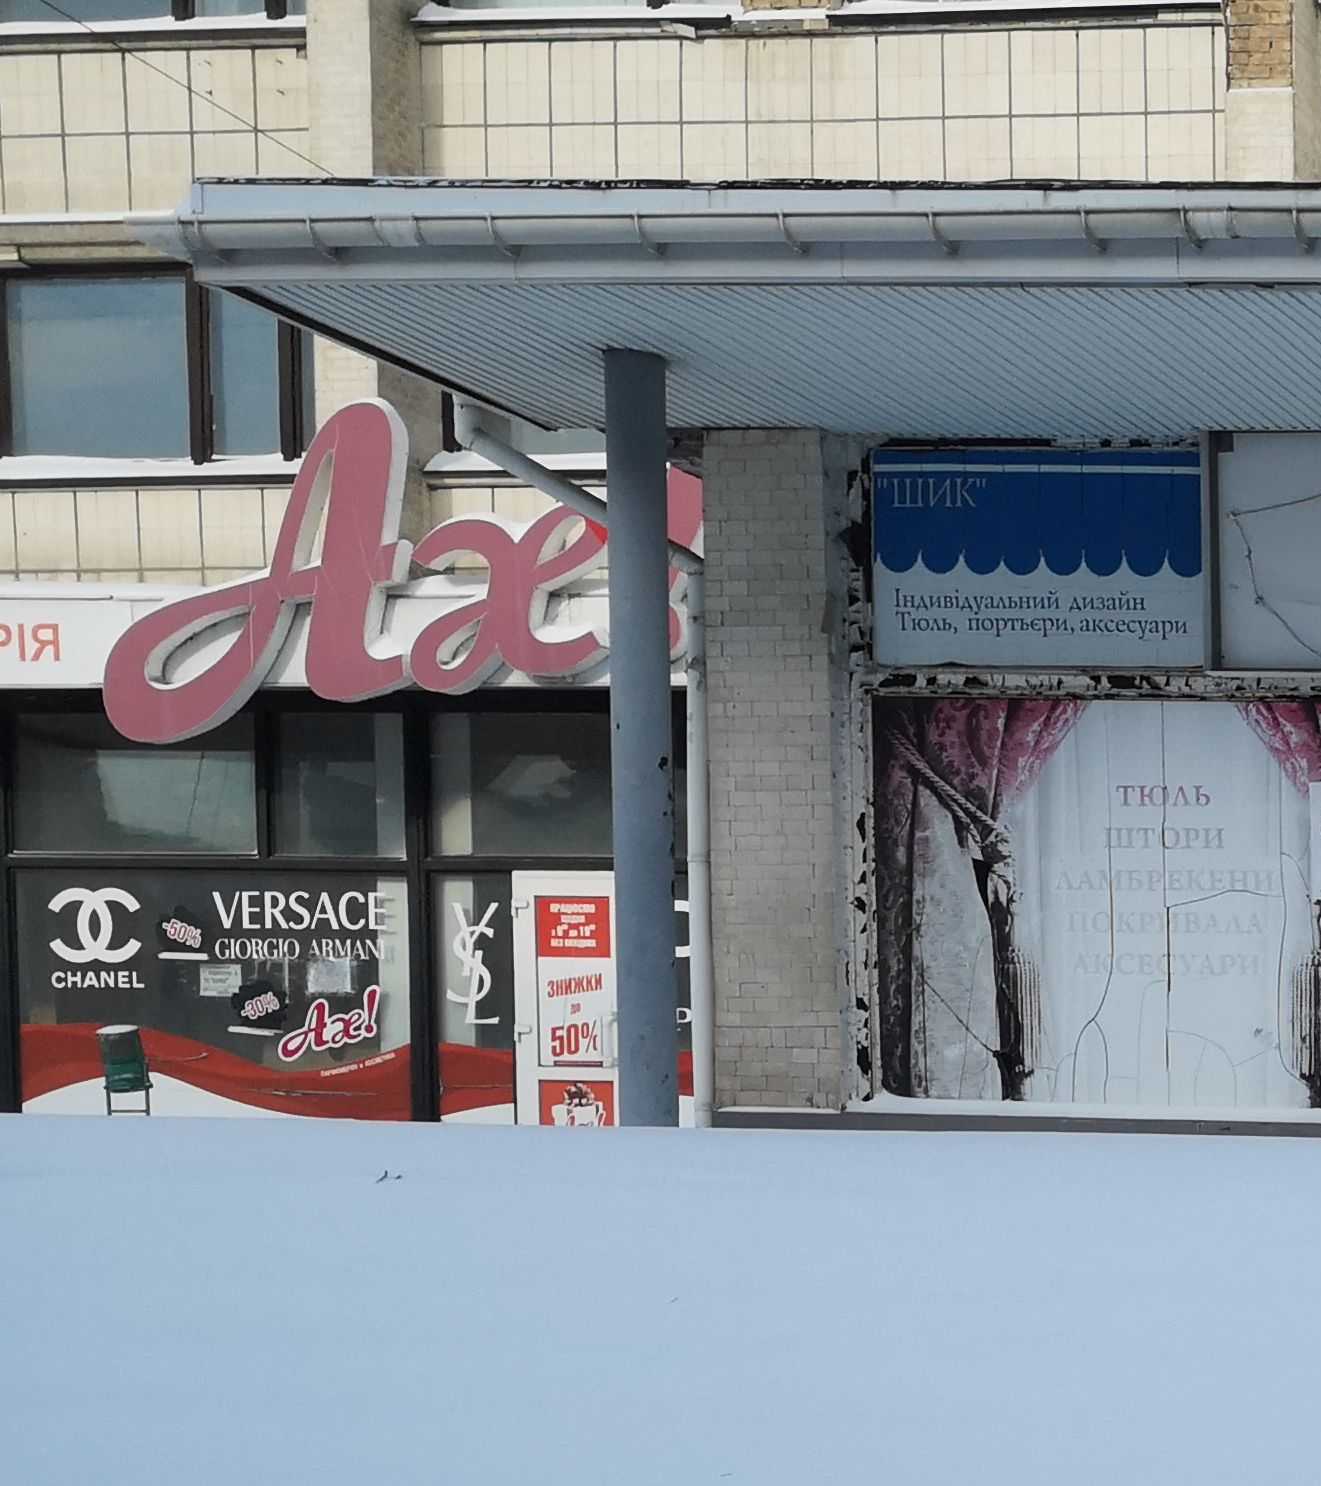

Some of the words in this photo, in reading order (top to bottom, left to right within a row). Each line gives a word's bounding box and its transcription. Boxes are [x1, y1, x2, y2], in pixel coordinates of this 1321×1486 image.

[876, 477, 988, 508] "ШИК"
[894, 588, 1060, 613] Індивідуальний
[1068, 591, 1146, 613] дизайн
[895, 611, 959, 634] Тюль,
[967, 615, 1075, 638] портьєри,
[1079, 618, 1189, 641] аксесуари
[1116, 785, 1211, 807] ТЮЛЬ
[1104, 827, 1225, 849] ШТОРИ
[1055, 870, 1273, 891] ЛАМБРЕКЕНИ
[212, 891, 387, 930] VERSACE
[161, 919, 202, 948] -50%
[214, 938, 300, 960] GIORGIO
[309, 938, 385, 960] ARMANI
[51, 970, 144, 989] CHANEL
[547, 973, 603, 998] ЗНИЖКИ
[551, 1020, 598, 1057] 50%
